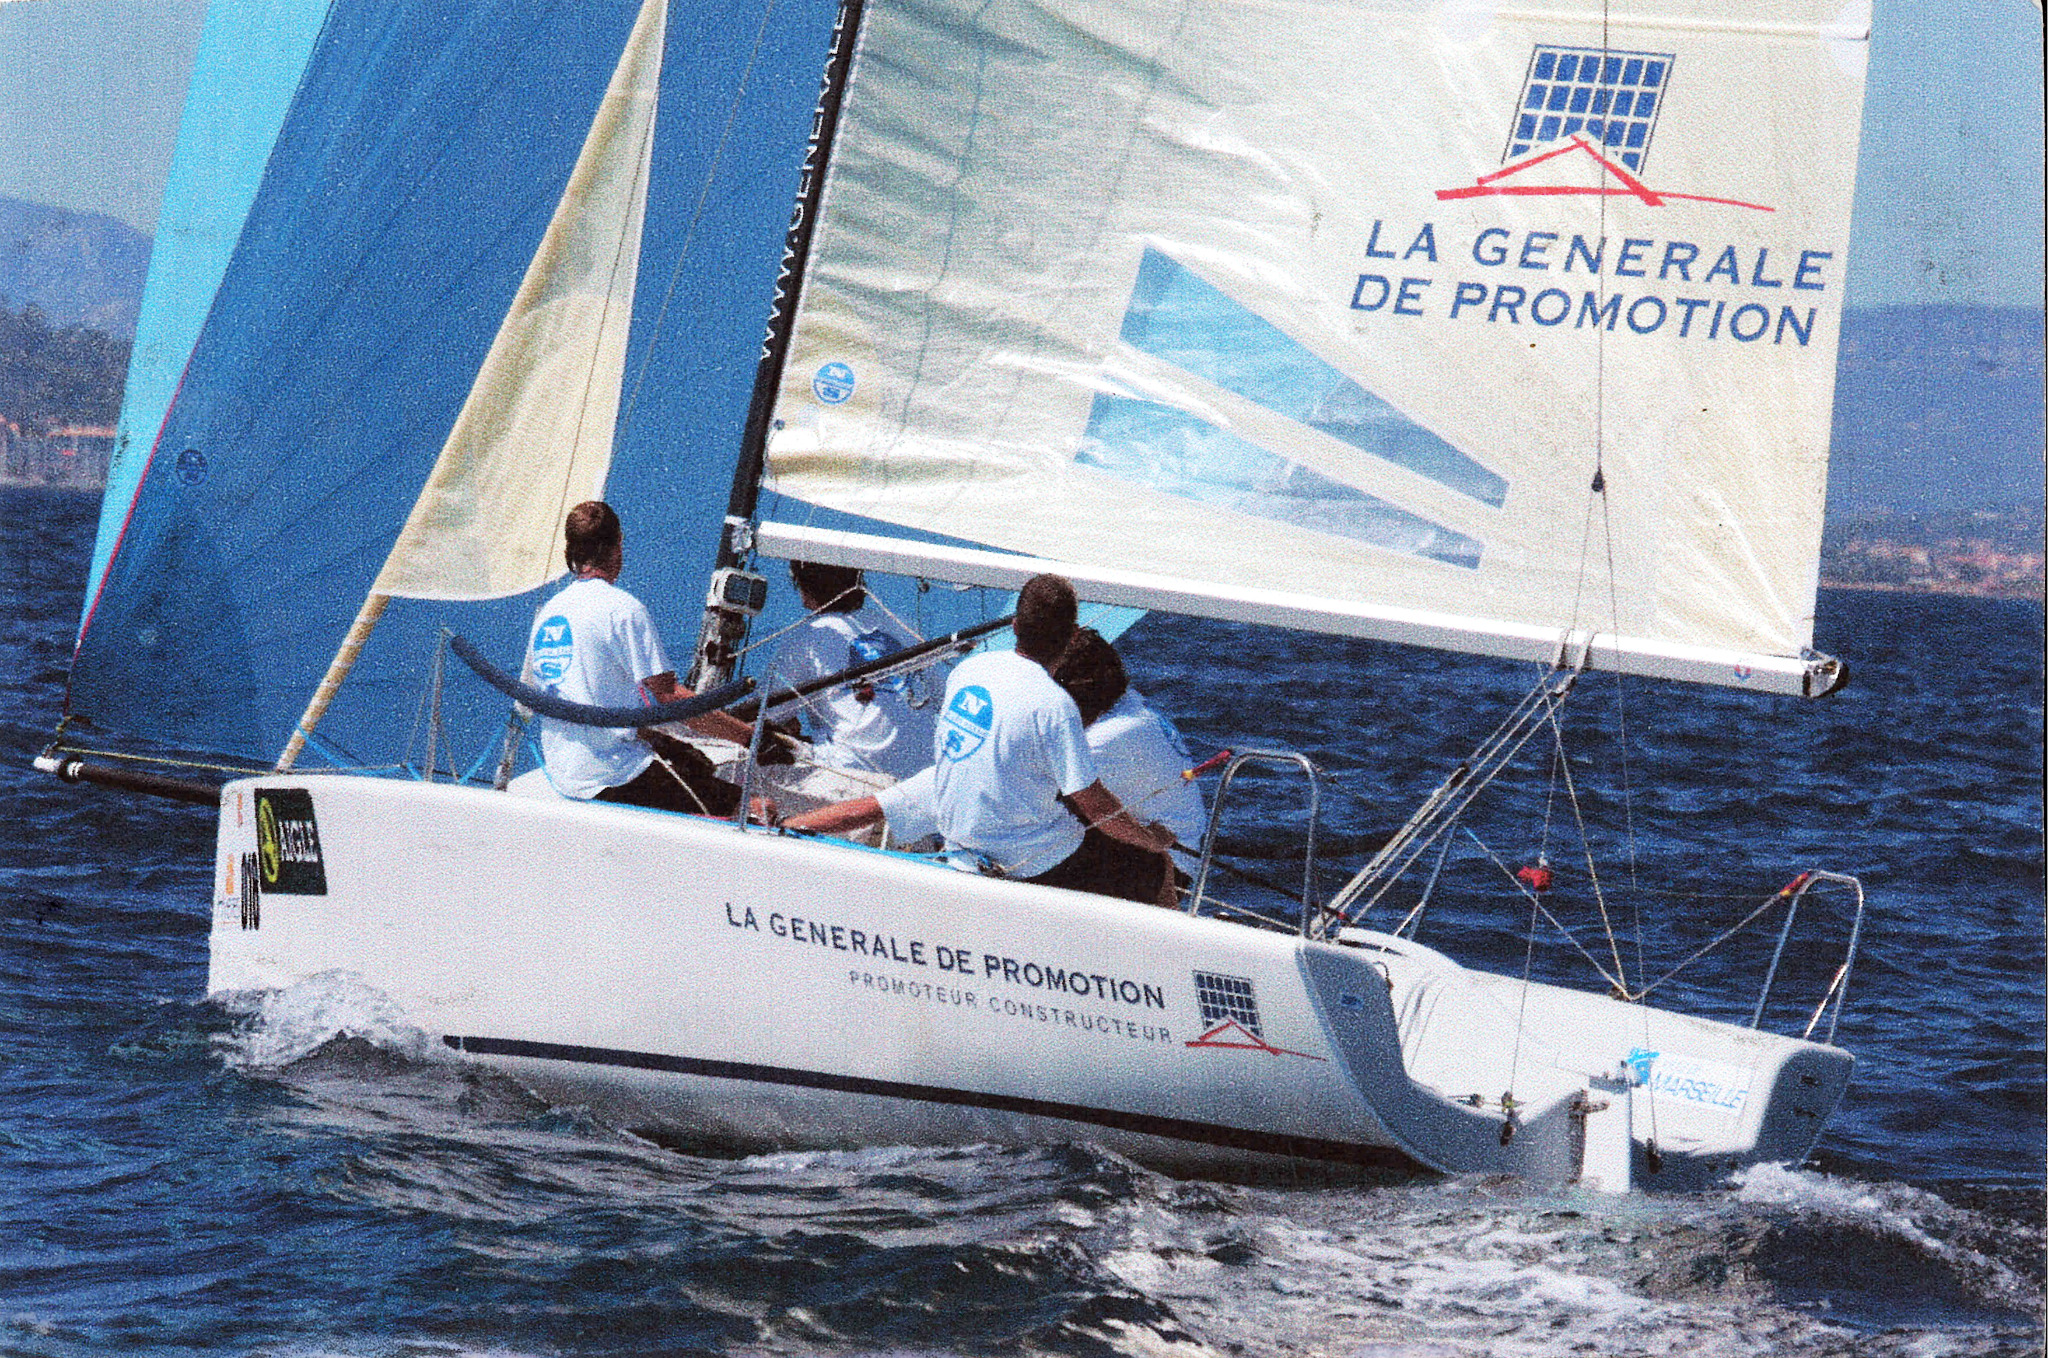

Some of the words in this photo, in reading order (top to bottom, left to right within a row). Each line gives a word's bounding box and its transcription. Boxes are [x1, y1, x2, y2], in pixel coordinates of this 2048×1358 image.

[1364, 219, 1438, 263] LA
[1471, 227, 1833, 291] GENERALE
[1349, 273, 1432, 318] DE
[1449, 281, 1816, 347] PROMOTION
[725, 901, 759, 932] LA
[769, 912, 927, 966] GENERALE
[936, 945, 975, 975] DE
[983, 953, 1165, 1009] PROMOTION
[849, 970, 977, 1008] PROMOTEUR
[989, 996, 1172, 1043] CONSTRUCTEUR
